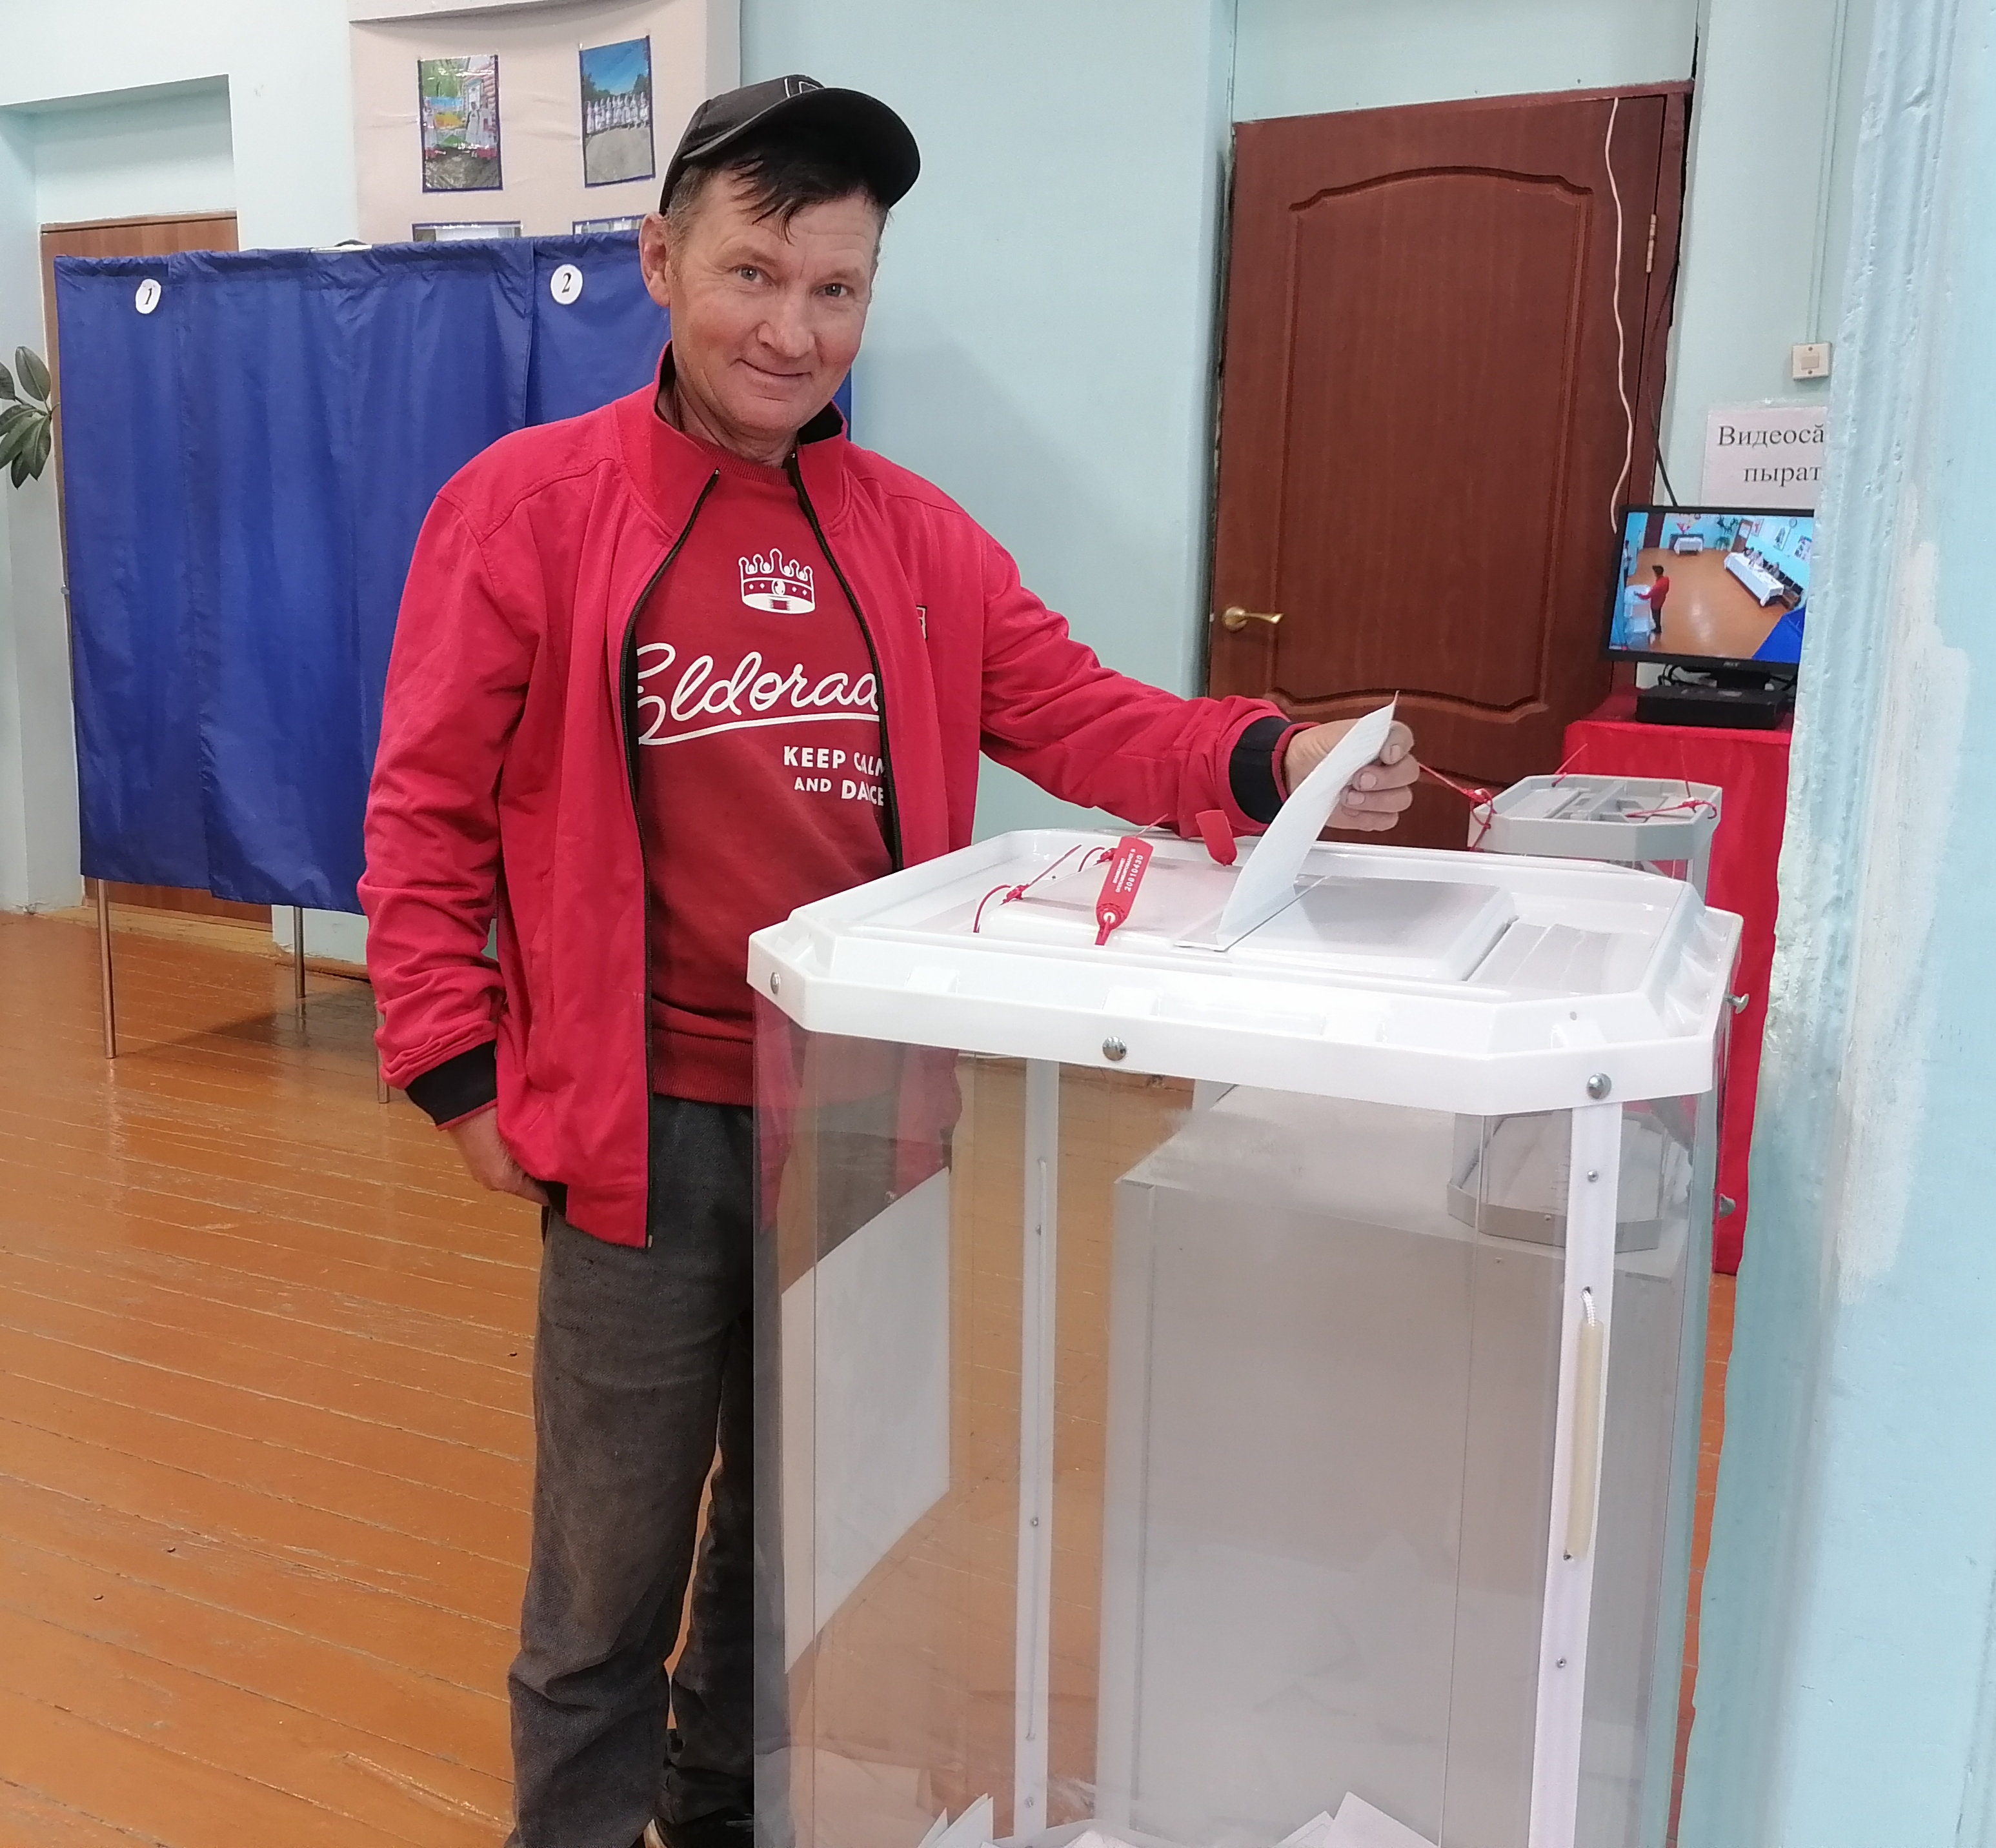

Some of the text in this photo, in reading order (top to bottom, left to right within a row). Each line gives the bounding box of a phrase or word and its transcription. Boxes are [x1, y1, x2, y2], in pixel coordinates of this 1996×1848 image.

[561, 272, 572, 293] 2
[143, 286, 153, 305] 1
[1743, 466, 1822, 487] пырат
[783, 746, 847, 769] KEEP
[794, 777, 832, 792] AND
